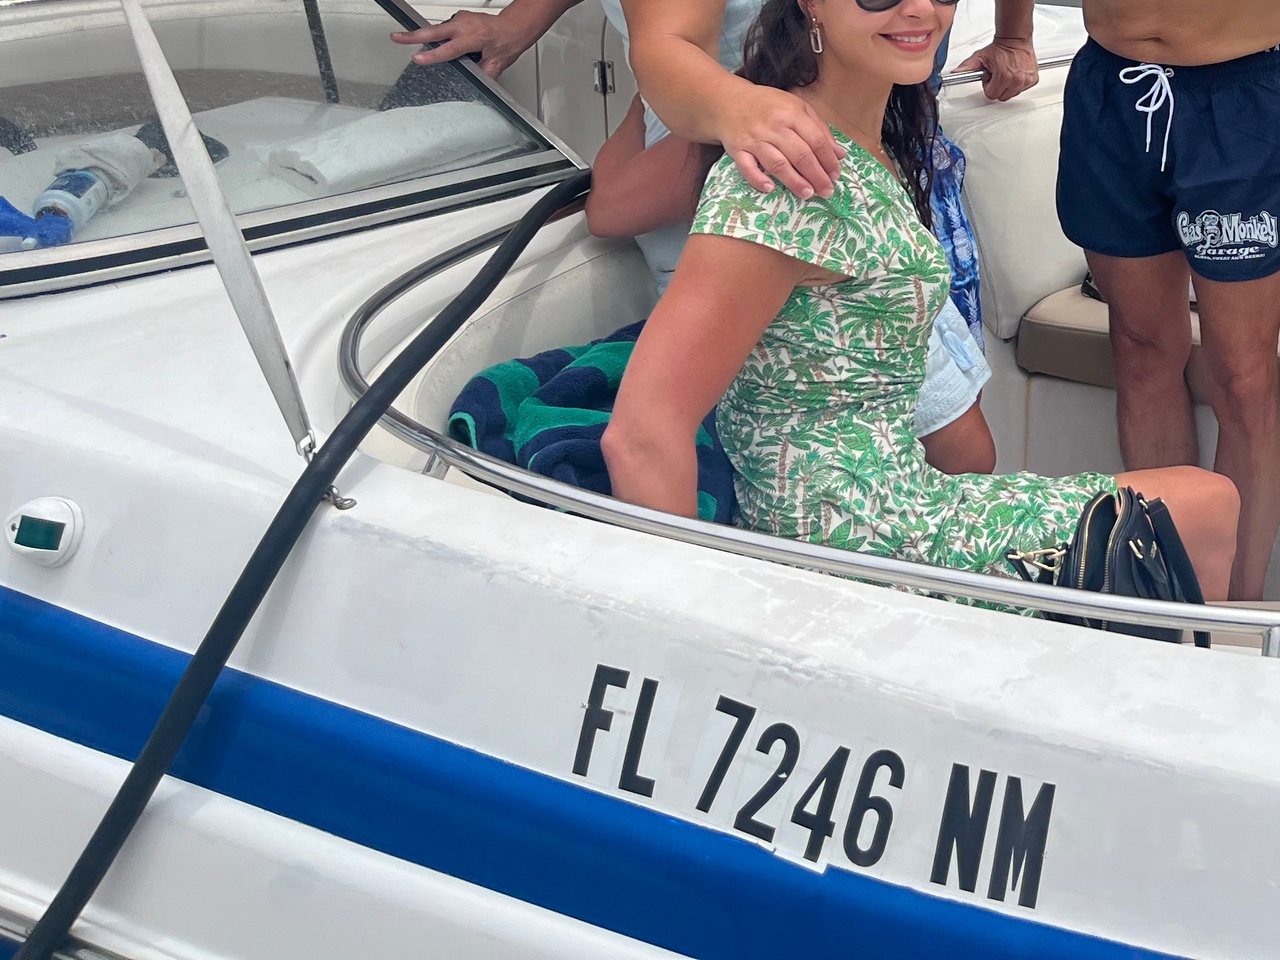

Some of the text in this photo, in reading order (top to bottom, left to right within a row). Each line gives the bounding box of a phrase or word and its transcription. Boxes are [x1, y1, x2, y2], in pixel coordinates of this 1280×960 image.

[1177, 210, 1279, 249] Gas Monkey
[571, 663, 1056, 910] FL 7246 NM
